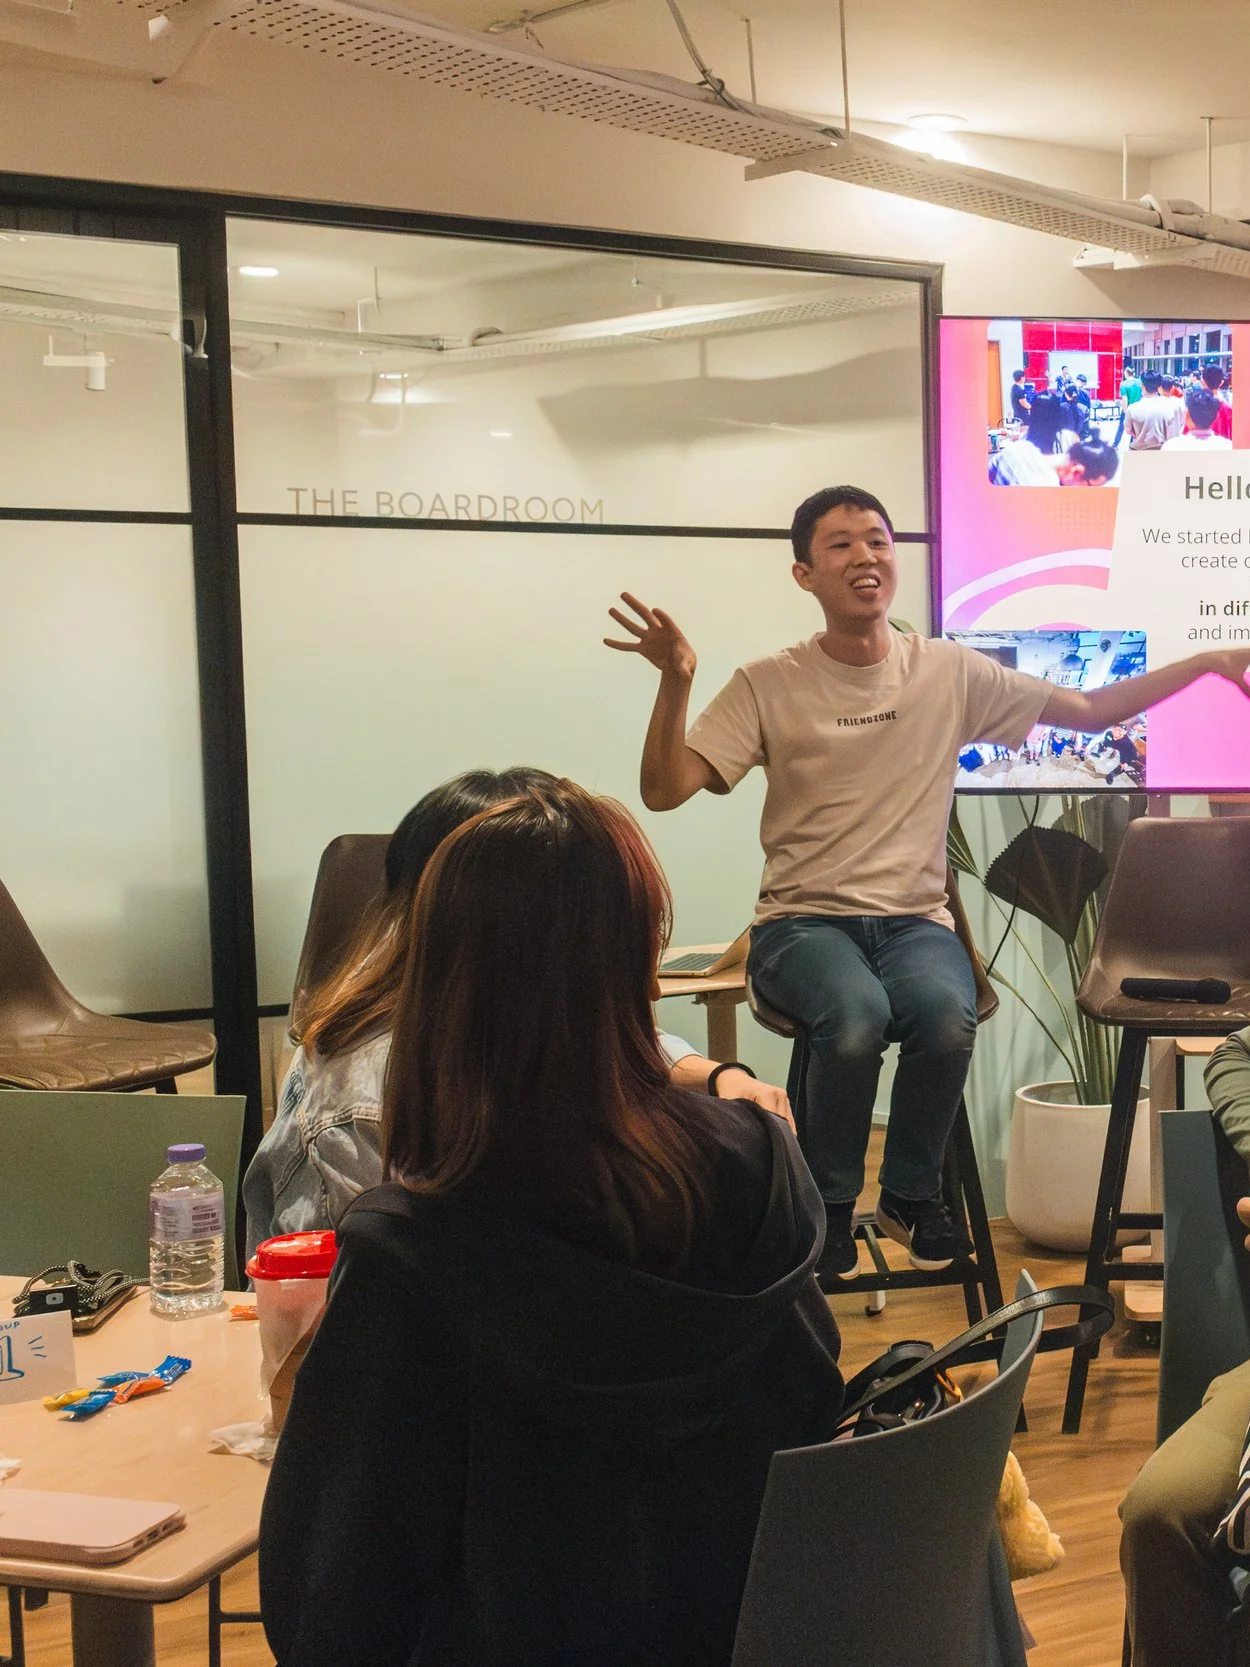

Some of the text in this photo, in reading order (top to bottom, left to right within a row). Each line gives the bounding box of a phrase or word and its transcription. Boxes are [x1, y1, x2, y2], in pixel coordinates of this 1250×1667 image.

[286, 487, 604, 524] THE BOARDROOM
[1142, 528, 1172, 545] We
[1177, 528, 1242, 545] started
[1181, 555, 1238, 569] create
[1199, 600, 1217, 617] in
[1187, 623, 1222, 641] and
[836, 710, 897, 727] FRIENDZONE
